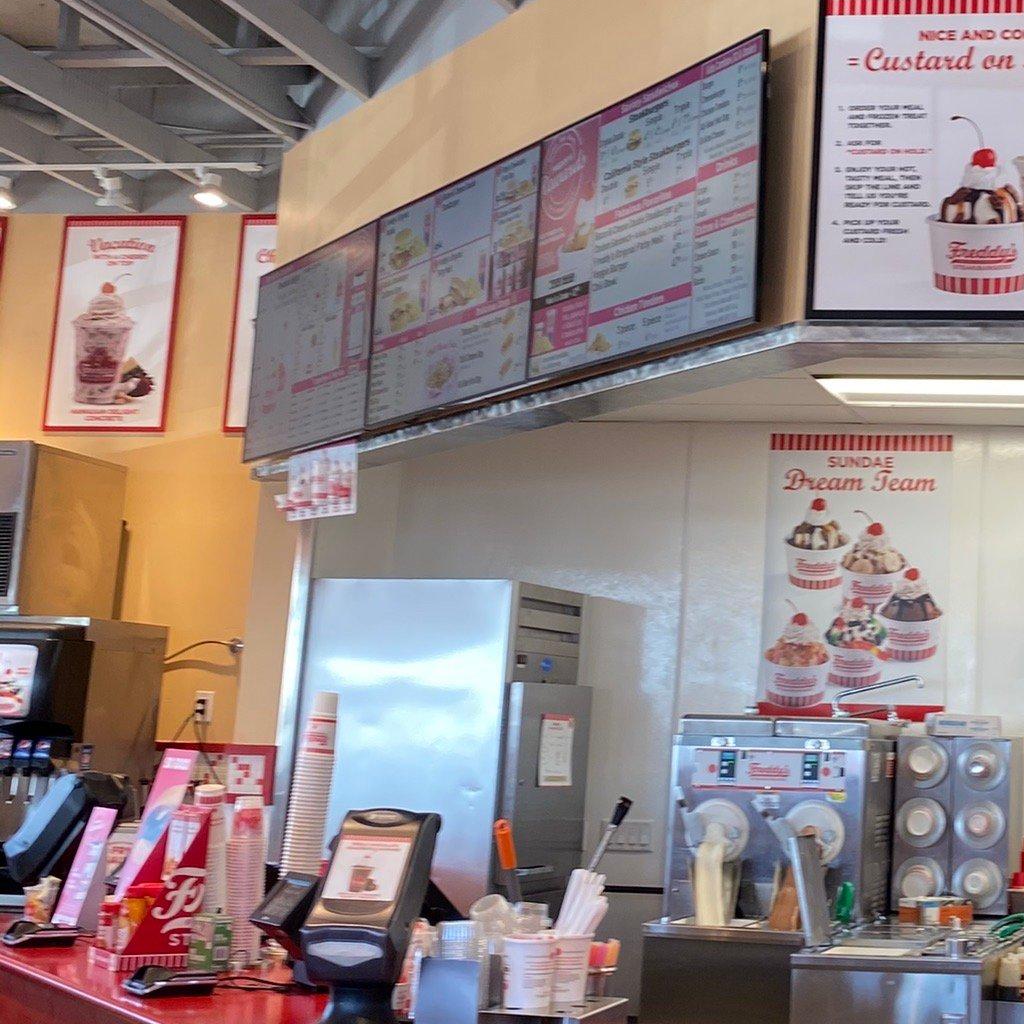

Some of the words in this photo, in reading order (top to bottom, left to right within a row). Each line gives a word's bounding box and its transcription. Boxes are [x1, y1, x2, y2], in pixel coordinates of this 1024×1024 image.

[919, 29, 957, 41] NICE
[961, 29, 995, 41] AND
[864, 46, 975, 71] Custard
[982, 54, 1014, 70] on
[827, 456, 895, 468] SUNDAE
[783, 468, 864, 491] Dream
[872, 470, 938, 492] Team
